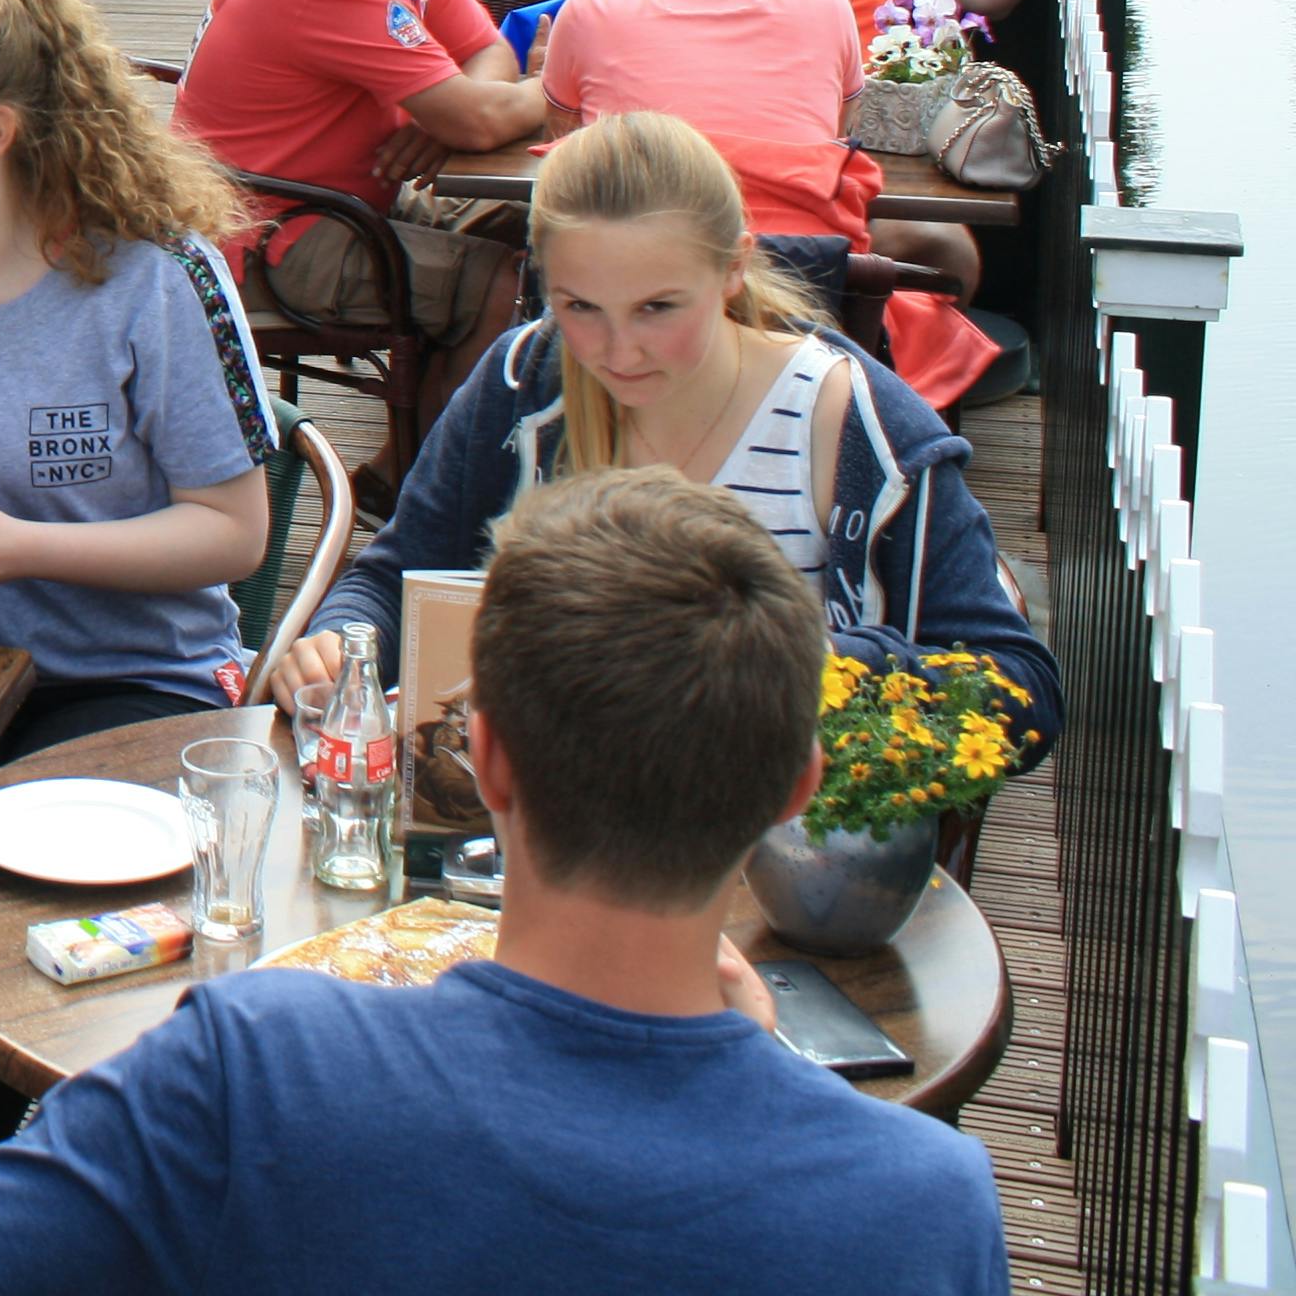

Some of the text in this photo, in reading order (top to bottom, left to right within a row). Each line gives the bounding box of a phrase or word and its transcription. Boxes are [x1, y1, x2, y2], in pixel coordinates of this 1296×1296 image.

[46, 410, 93, 430] THE
[28, 435, 112, 458] BRONX
[48, 462, 95, 483] NYC
